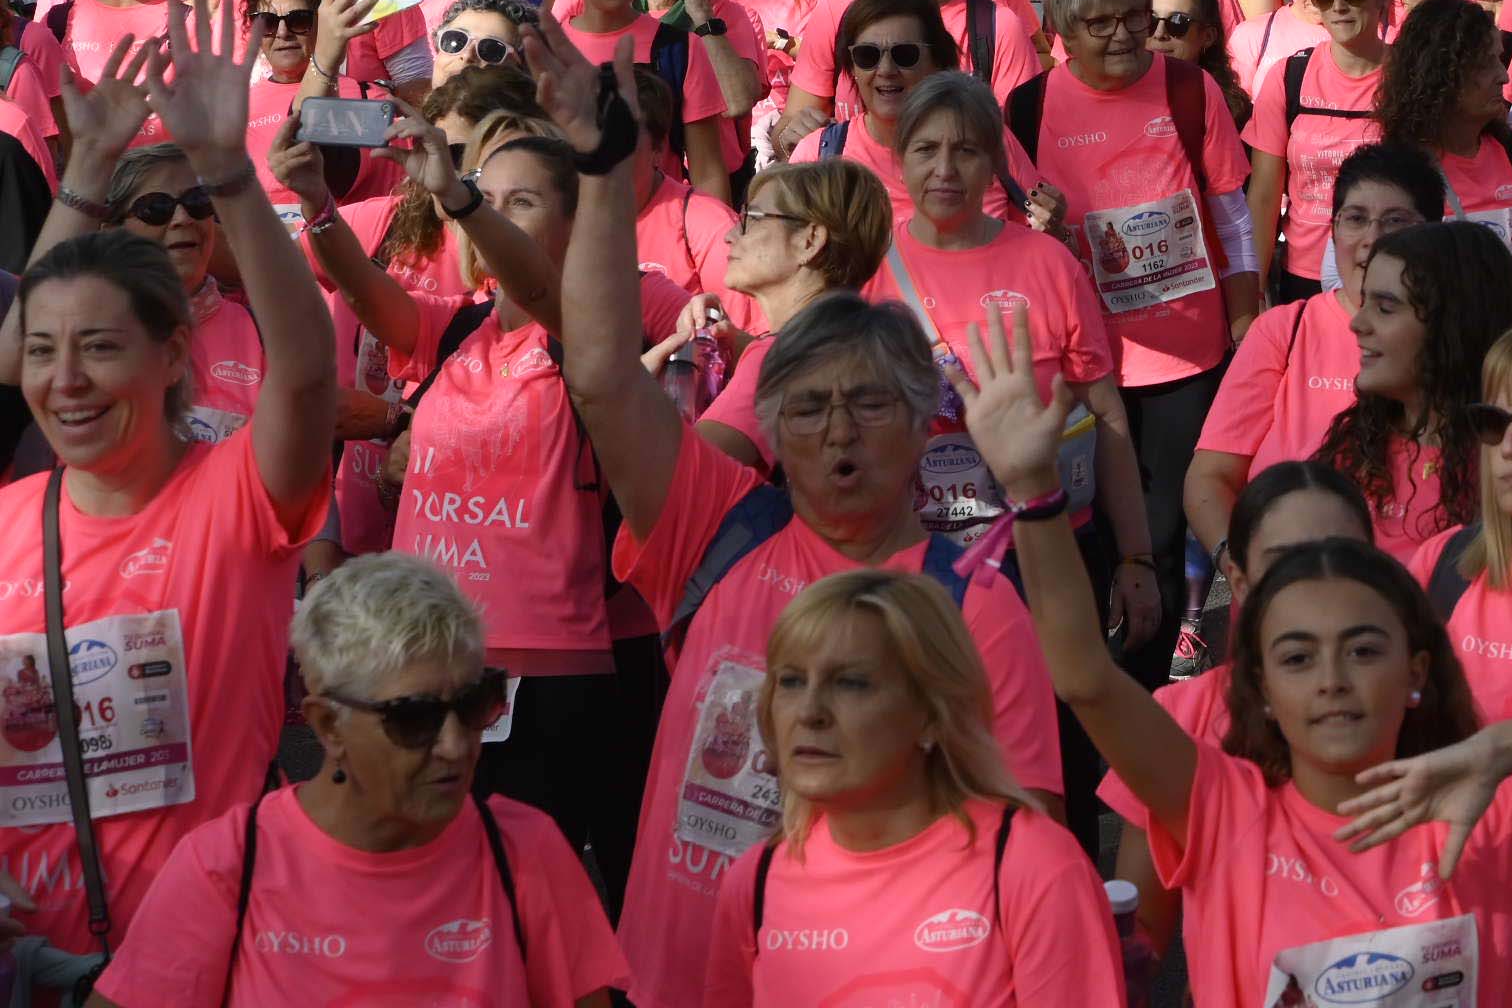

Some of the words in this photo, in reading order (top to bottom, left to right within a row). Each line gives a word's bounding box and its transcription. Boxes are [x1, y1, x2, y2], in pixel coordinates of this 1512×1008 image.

[1058, 131, 1107, 148] OYSHO
[1132, 240, 1169, 260] 016
[1142, 258, 1165, 273] 1162
[1171, 275, 1205, 292] Santander
[929, 482, 977, 501] 016
[936, 506, 974, 518] 27442
[124, 638, 166, 651] SUMA
[699, 791, 743, 815] CARRERA
[687, 813, 737, 840] OYSHO
[767, 927, 849, 952] OYSHO
[920, 924, 985, 945] ASTURIANA
[254, 931, 346, 958] OYSHO
[1422, 945, 1462, 964] SUMA
[1320, 967, 1411, 999] ASTURIANA
